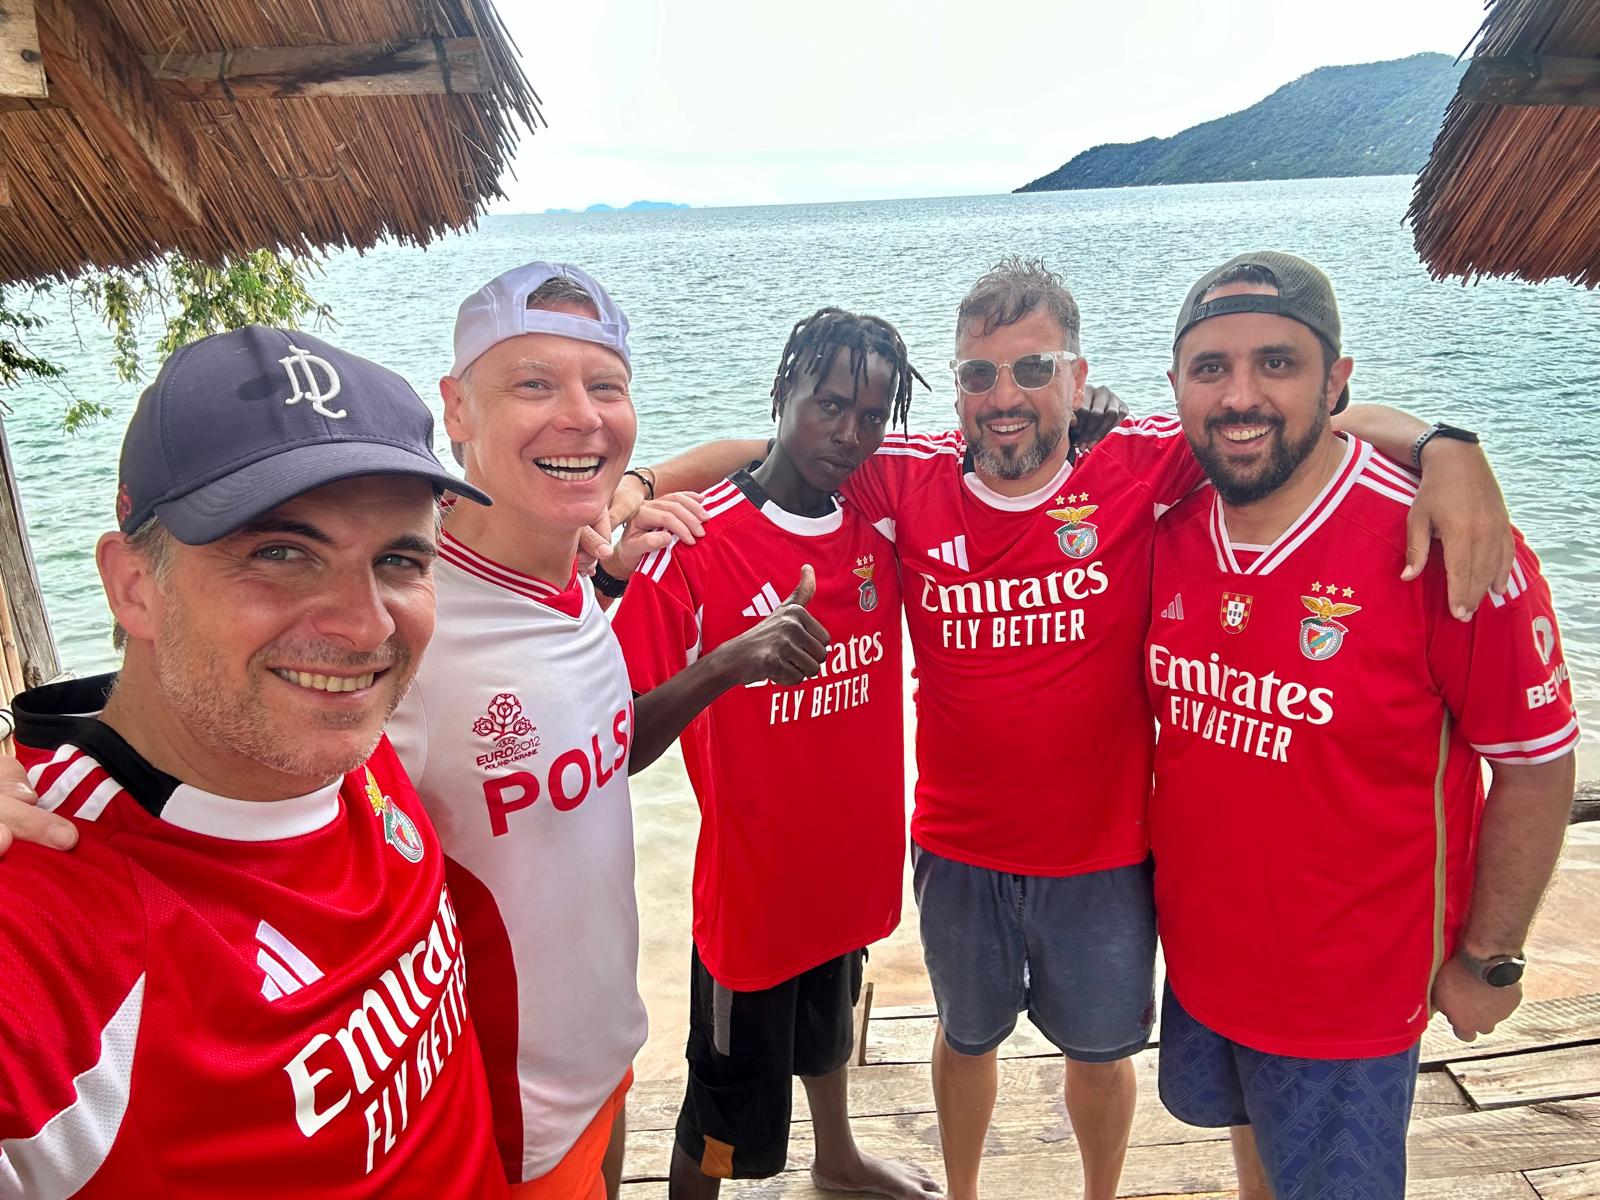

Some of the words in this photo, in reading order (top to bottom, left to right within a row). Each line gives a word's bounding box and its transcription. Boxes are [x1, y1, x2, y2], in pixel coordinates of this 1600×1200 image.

[920, 561, 1109, 613] Emirates
[942, 619, 981, 650] FLY
[992, 608, 1086, 649] BETTER
[770, 689, 805, 725] FLY
[811, 673, 870, 719] BETTER
[1150, 643, 1334, 726] Emirates
[1170, 695, 1205, 734] FLY
[1202, 704, 1293, 763] BETTER
[482, 700, 635, 838] POLS
[282, 881, 458, 1138] Emirat
[364, 1060, 408, 1175] FLY
